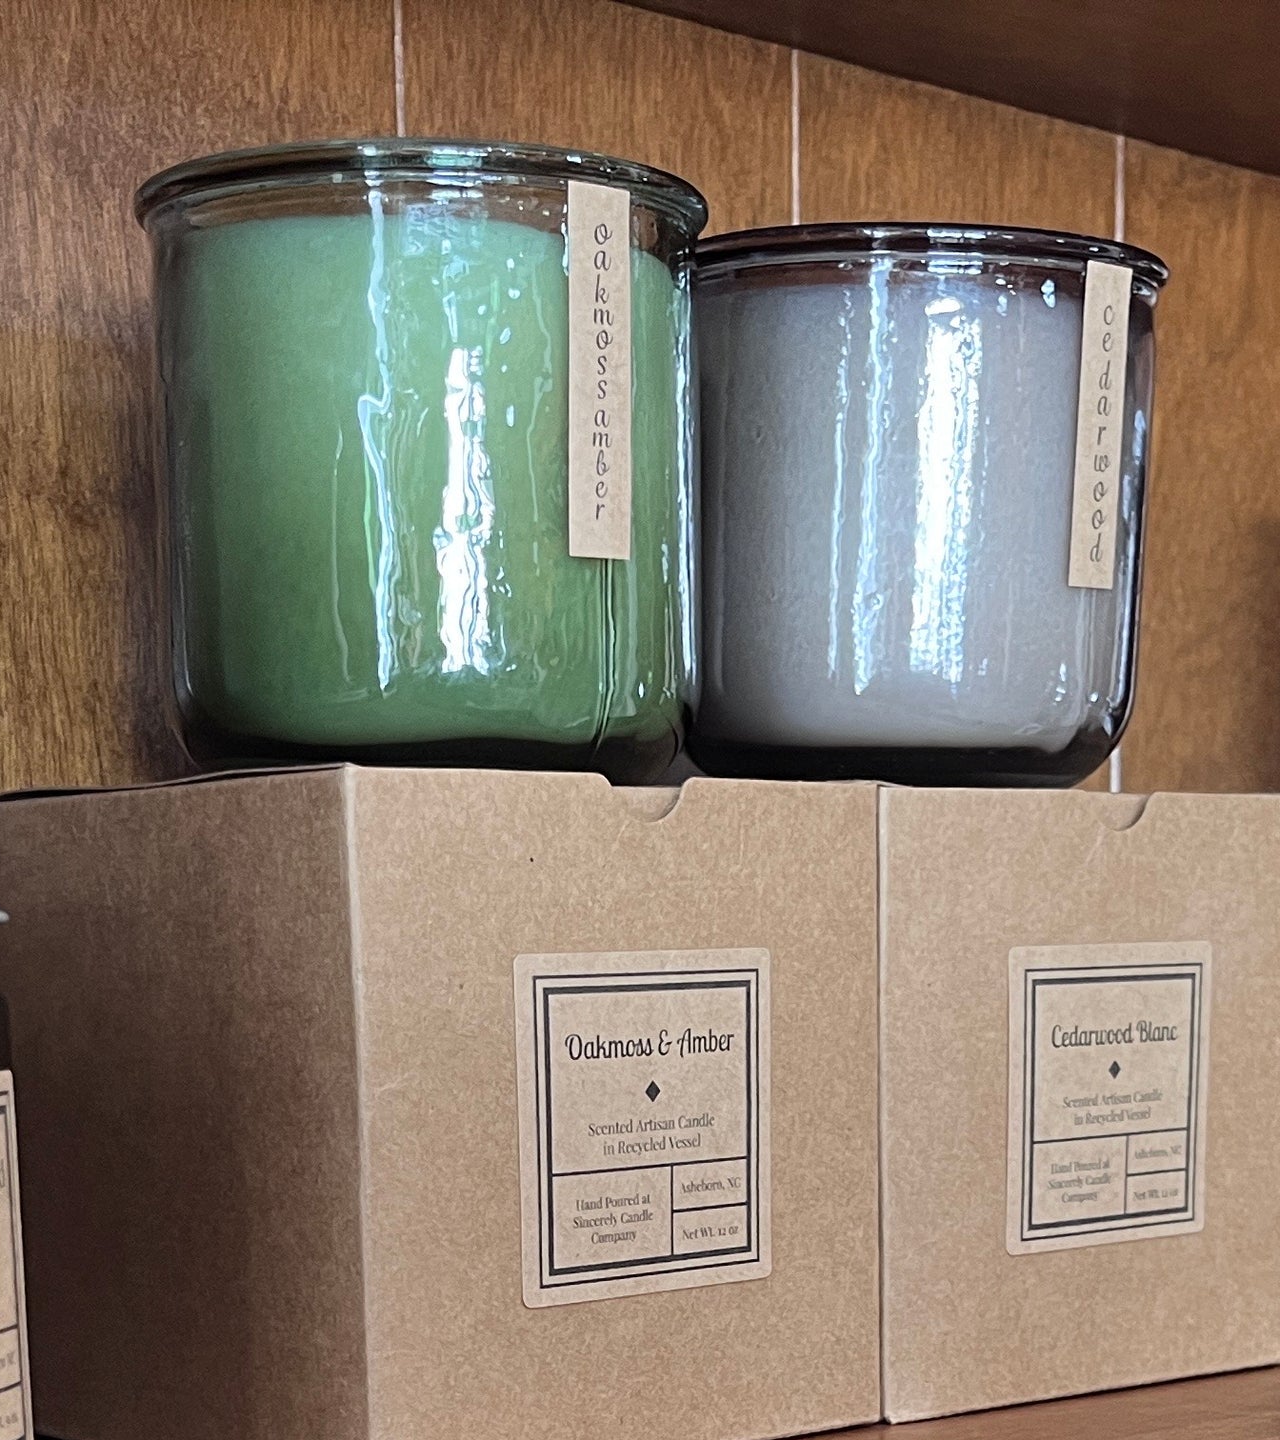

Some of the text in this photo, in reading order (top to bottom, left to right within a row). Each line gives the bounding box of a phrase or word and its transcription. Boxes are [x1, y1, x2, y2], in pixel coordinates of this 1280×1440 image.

[592, 223, 614, 520] oakmoss amber
[1090, 305, 1114, 562] cedarwood
[564, 1028, 735, 1060] Oakmoss & Amber
[1052, 1019, 1178, 1048] Cedarwood Blanc
[588, 1113, 715, 1137] Scented Artisan Candle
[603, 1133, 701, 1156] in Recycled Vessel
[727, 1177, 742, 1189] NC
[576, 1194, 651, 1211] Hand Poured at
[572, 1209, 654, 1229] Sincerely Candle
[591, 1230, 637, 1245] Company
[682, 1228, 700, 1240] Net
[728, 1225, 739, 1235] oz
